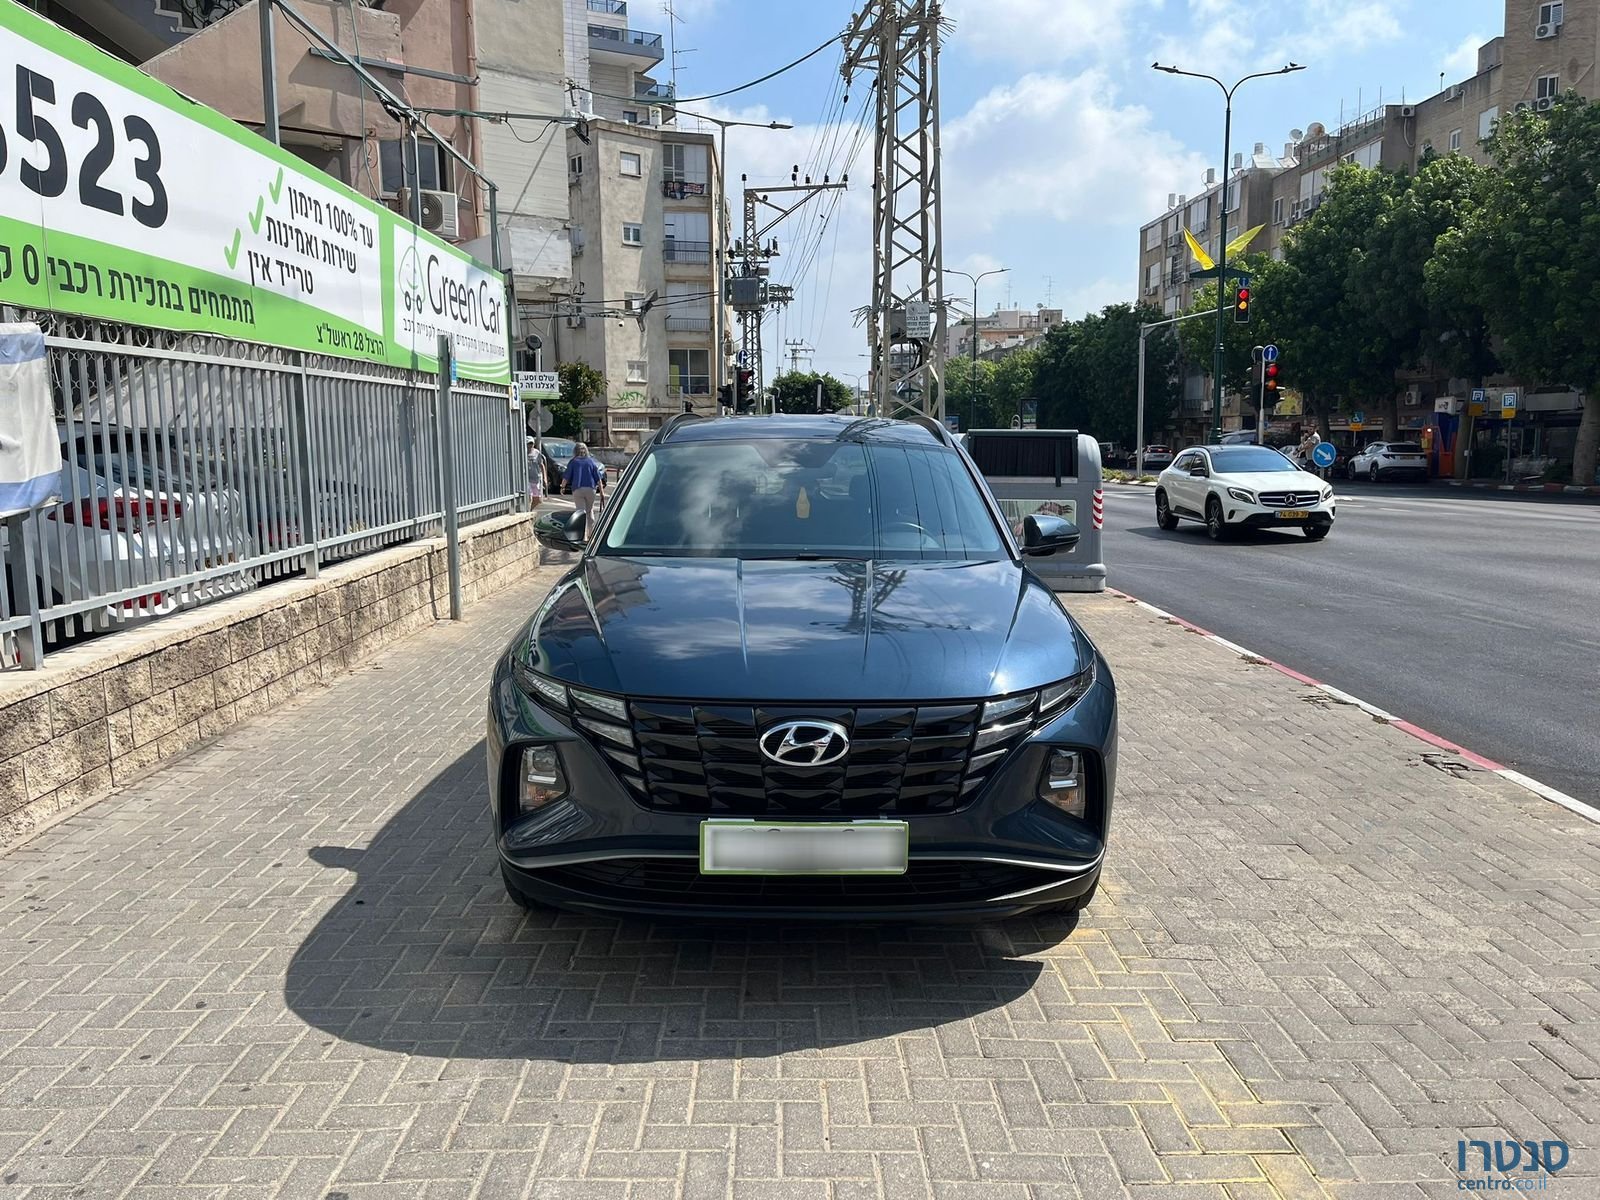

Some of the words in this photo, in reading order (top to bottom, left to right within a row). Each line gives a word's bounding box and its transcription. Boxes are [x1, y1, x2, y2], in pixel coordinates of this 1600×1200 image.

[0, 63, 169, 229] 523
[287, 186, 323, 226] מימון
[326, 203, 358, 242] 100%
[265, 215, 319, 260] ואמינות
[359, 223, 373, 249] עד
[247, 249, 273, 287] אין
[322, 239, 357, 274] שירות
[47, 256, 103, 297] רכבי
[108, 269, 185, 312] במכירת
[275, 259, 314, 295] טרייד
[427, 254, 478, 327] Green
[479, 279, 501, 335] Car
[187, 286, 255, 325] מתמחים
[353, 330, 364, 352] 28
[364, 333, 384, 356] הרצל
[403, 318, 415, 333] רכב
[535, 381, 555, 389] אצלנו
[538, 374, 555, 382] שלם
